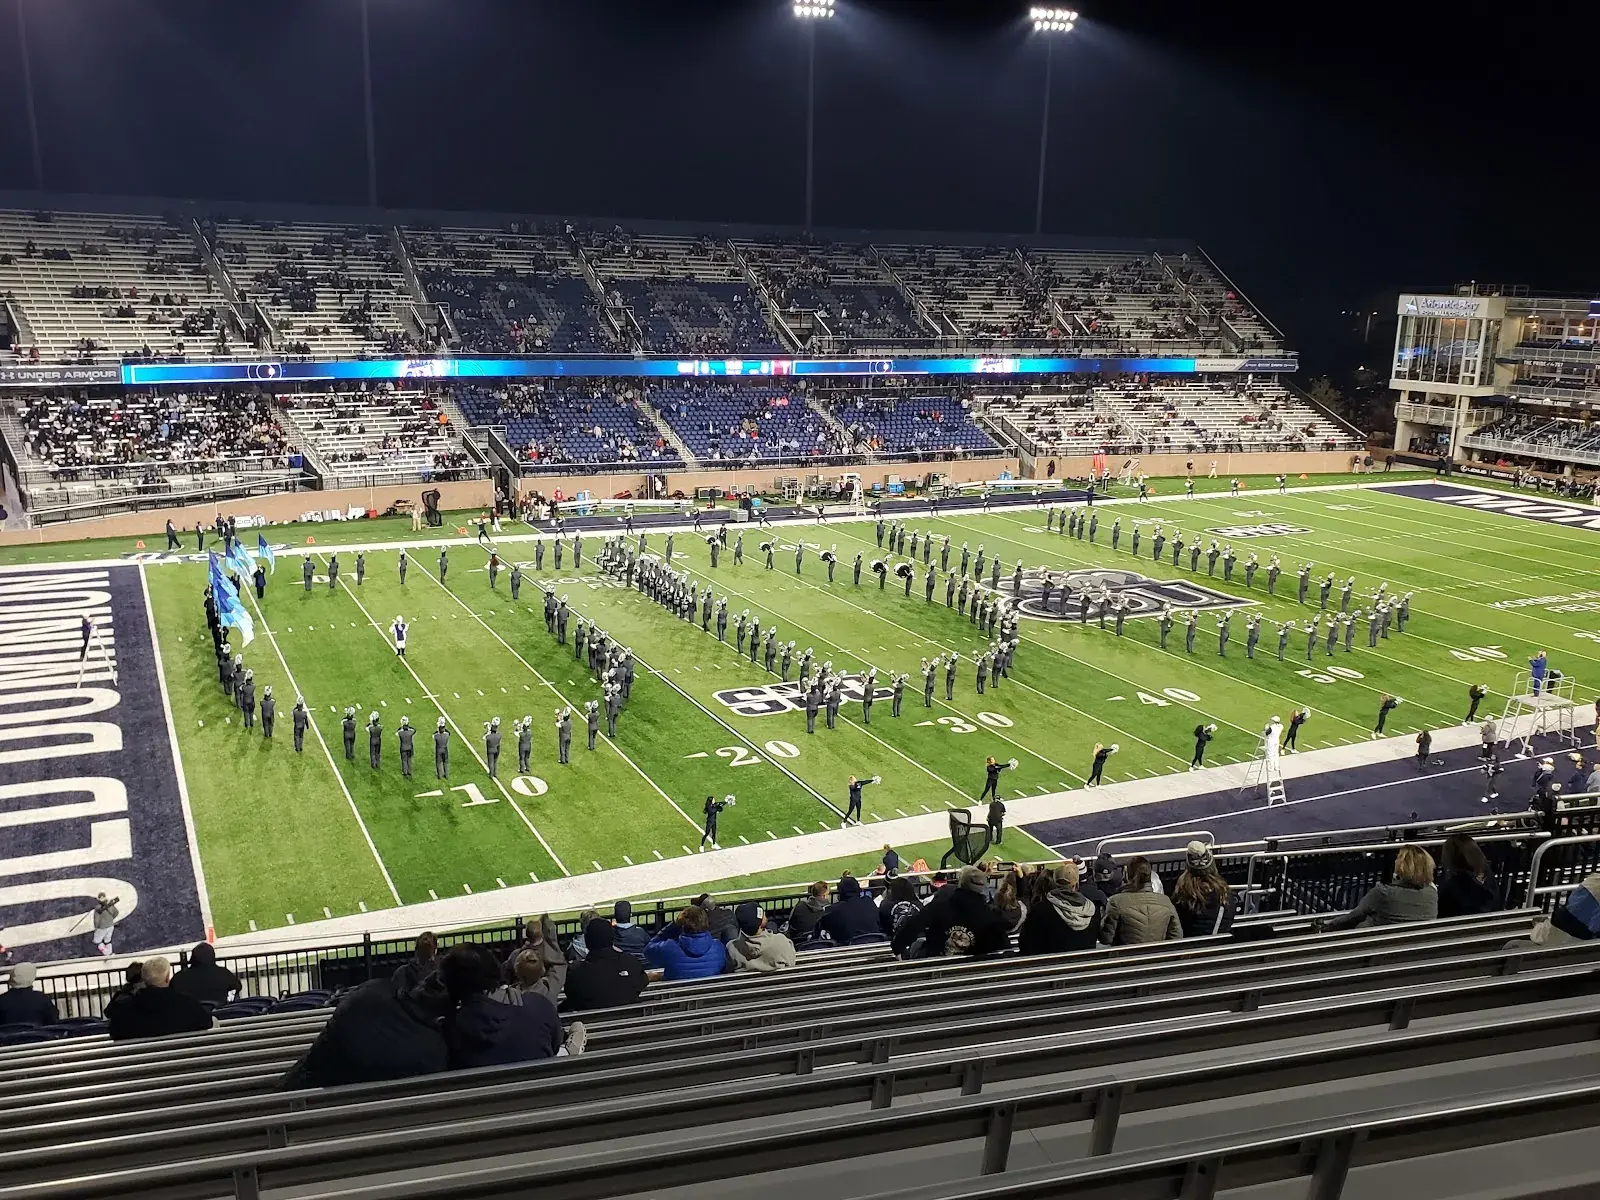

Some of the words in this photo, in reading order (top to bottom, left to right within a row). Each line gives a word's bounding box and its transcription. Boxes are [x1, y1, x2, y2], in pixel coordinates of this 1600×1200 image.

[17, 371, 61, 379] UNDER
[63, 370, 117, 378] ARMOUR
[1450, 646, 1508, 662] 40
[1294, 666, 1365, 684] 50
[1136, 688, 1202, 708] 40
[936, 711, 1015, 734] 30
[715, 740, 801, 767] 20
[449, 775, 549, 807] 10
